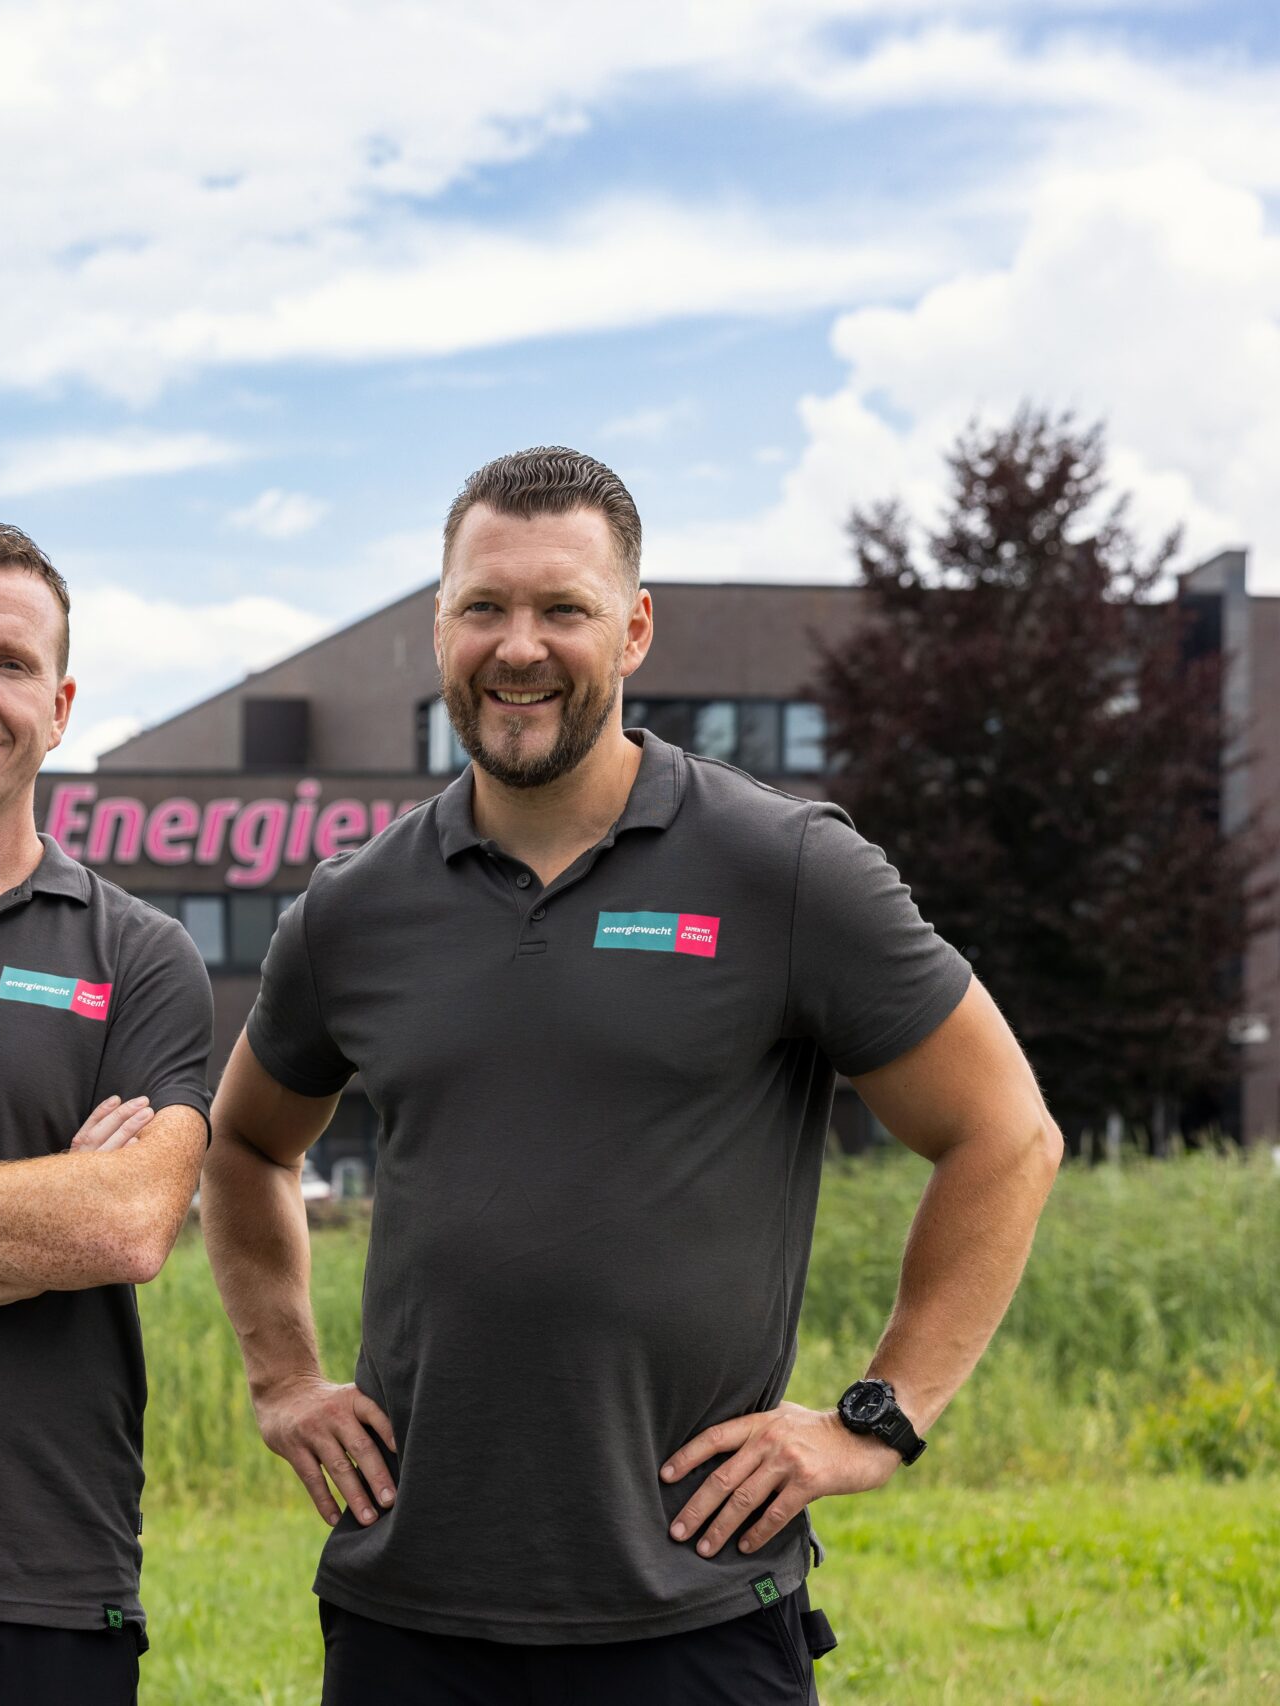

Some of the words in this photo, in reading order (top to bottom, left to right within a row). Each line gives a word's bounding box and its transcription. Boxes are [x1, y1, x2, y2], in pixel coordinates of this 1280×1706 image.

[603, 925, 672, 935] energiewacht
[681, 931, 713, 943] essent
[5, 980, 70, 996] energiewacht
[77, 995, 105, 1007] essent
